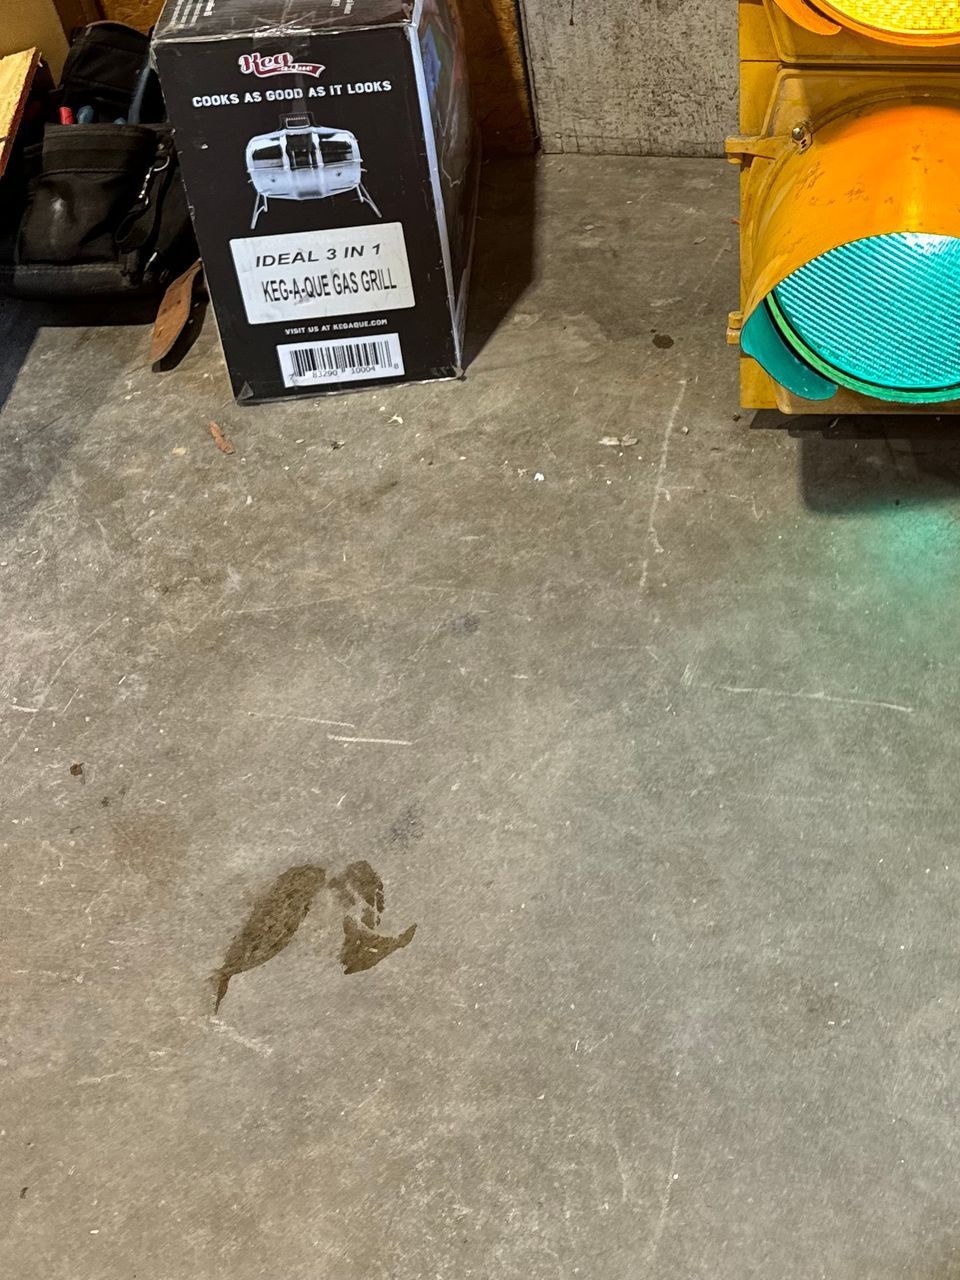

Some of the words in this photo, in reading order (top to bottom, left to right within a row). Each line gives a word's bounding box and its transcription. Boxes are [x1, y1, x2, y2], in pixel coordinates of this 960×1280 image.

[238, 52, 293, 74] Keg
[192, 92, 240, 108] COOKS
[244, 91, 263, 104] AS
[265, 87, 305, 101] GOOD
[307, 85, 327, 98] AS
[329, 83, 344, 97] IT
[346, 80, 393, 95] LOOKS
[255, 250, 320, 268] IDEAL
[325, 246, 337, 261] 3
[343, 244, 367, 259] IN
[373, 242, 382, 256] 1
[261, 276, 331, 303] KEG-A-QUE
[332, 273, 359, 297] GAS
[361, 268, 398, 293] GRILL
[285, 327, 305, 335] VISIT
[333, 319, 388, 330] KEGAQUE.COM
[352, 366, 376, 374] 10004
